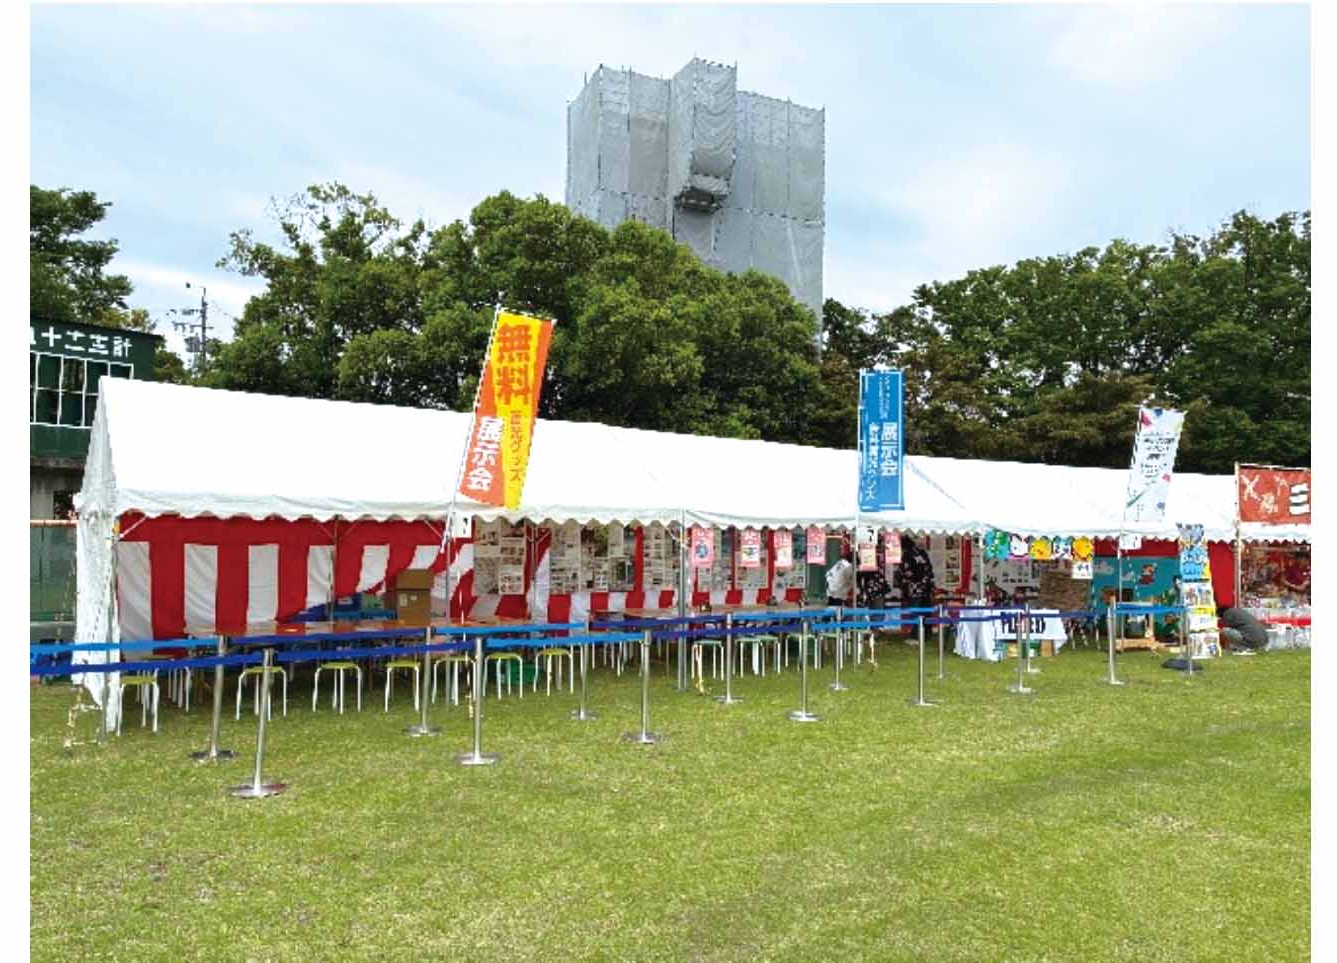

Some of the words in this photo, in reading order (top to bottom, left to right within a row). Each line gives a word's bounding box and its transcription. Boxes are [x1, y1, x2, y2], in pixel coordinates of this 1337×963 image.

[497, 322, 531, 405] 無料
[467, 416, 504, 492] 展示会
[880, 422, 898, 477] 展示会
